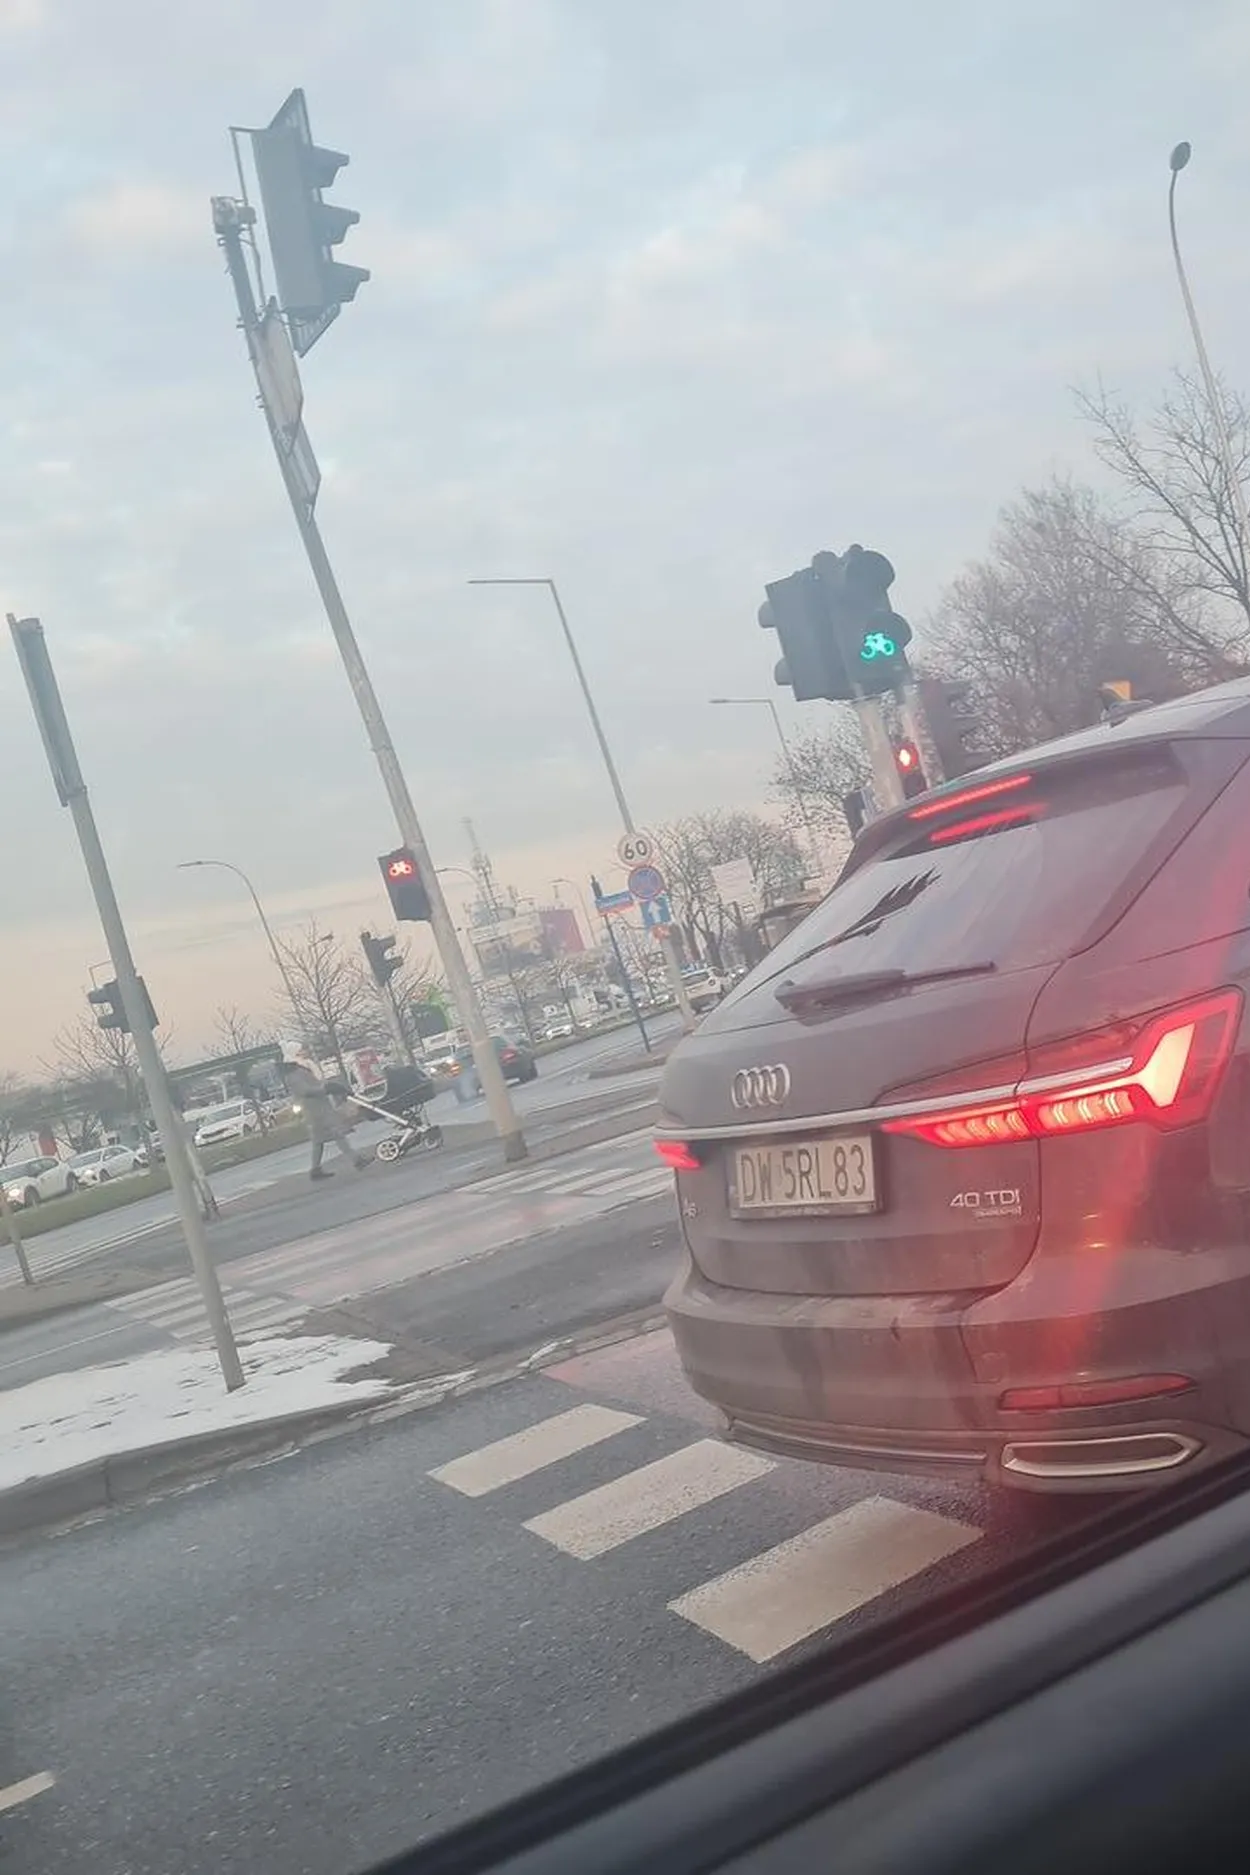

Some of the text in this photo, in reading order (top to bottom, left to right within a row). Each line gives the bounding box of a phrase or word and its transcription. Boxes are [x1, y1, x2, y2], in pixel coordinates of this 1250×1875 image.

[624, 840, 647, 860] 60
[741, 1144, 866, 1202] DW 5RL83
[950, 1189, 1020, 1208] 40 TDI
